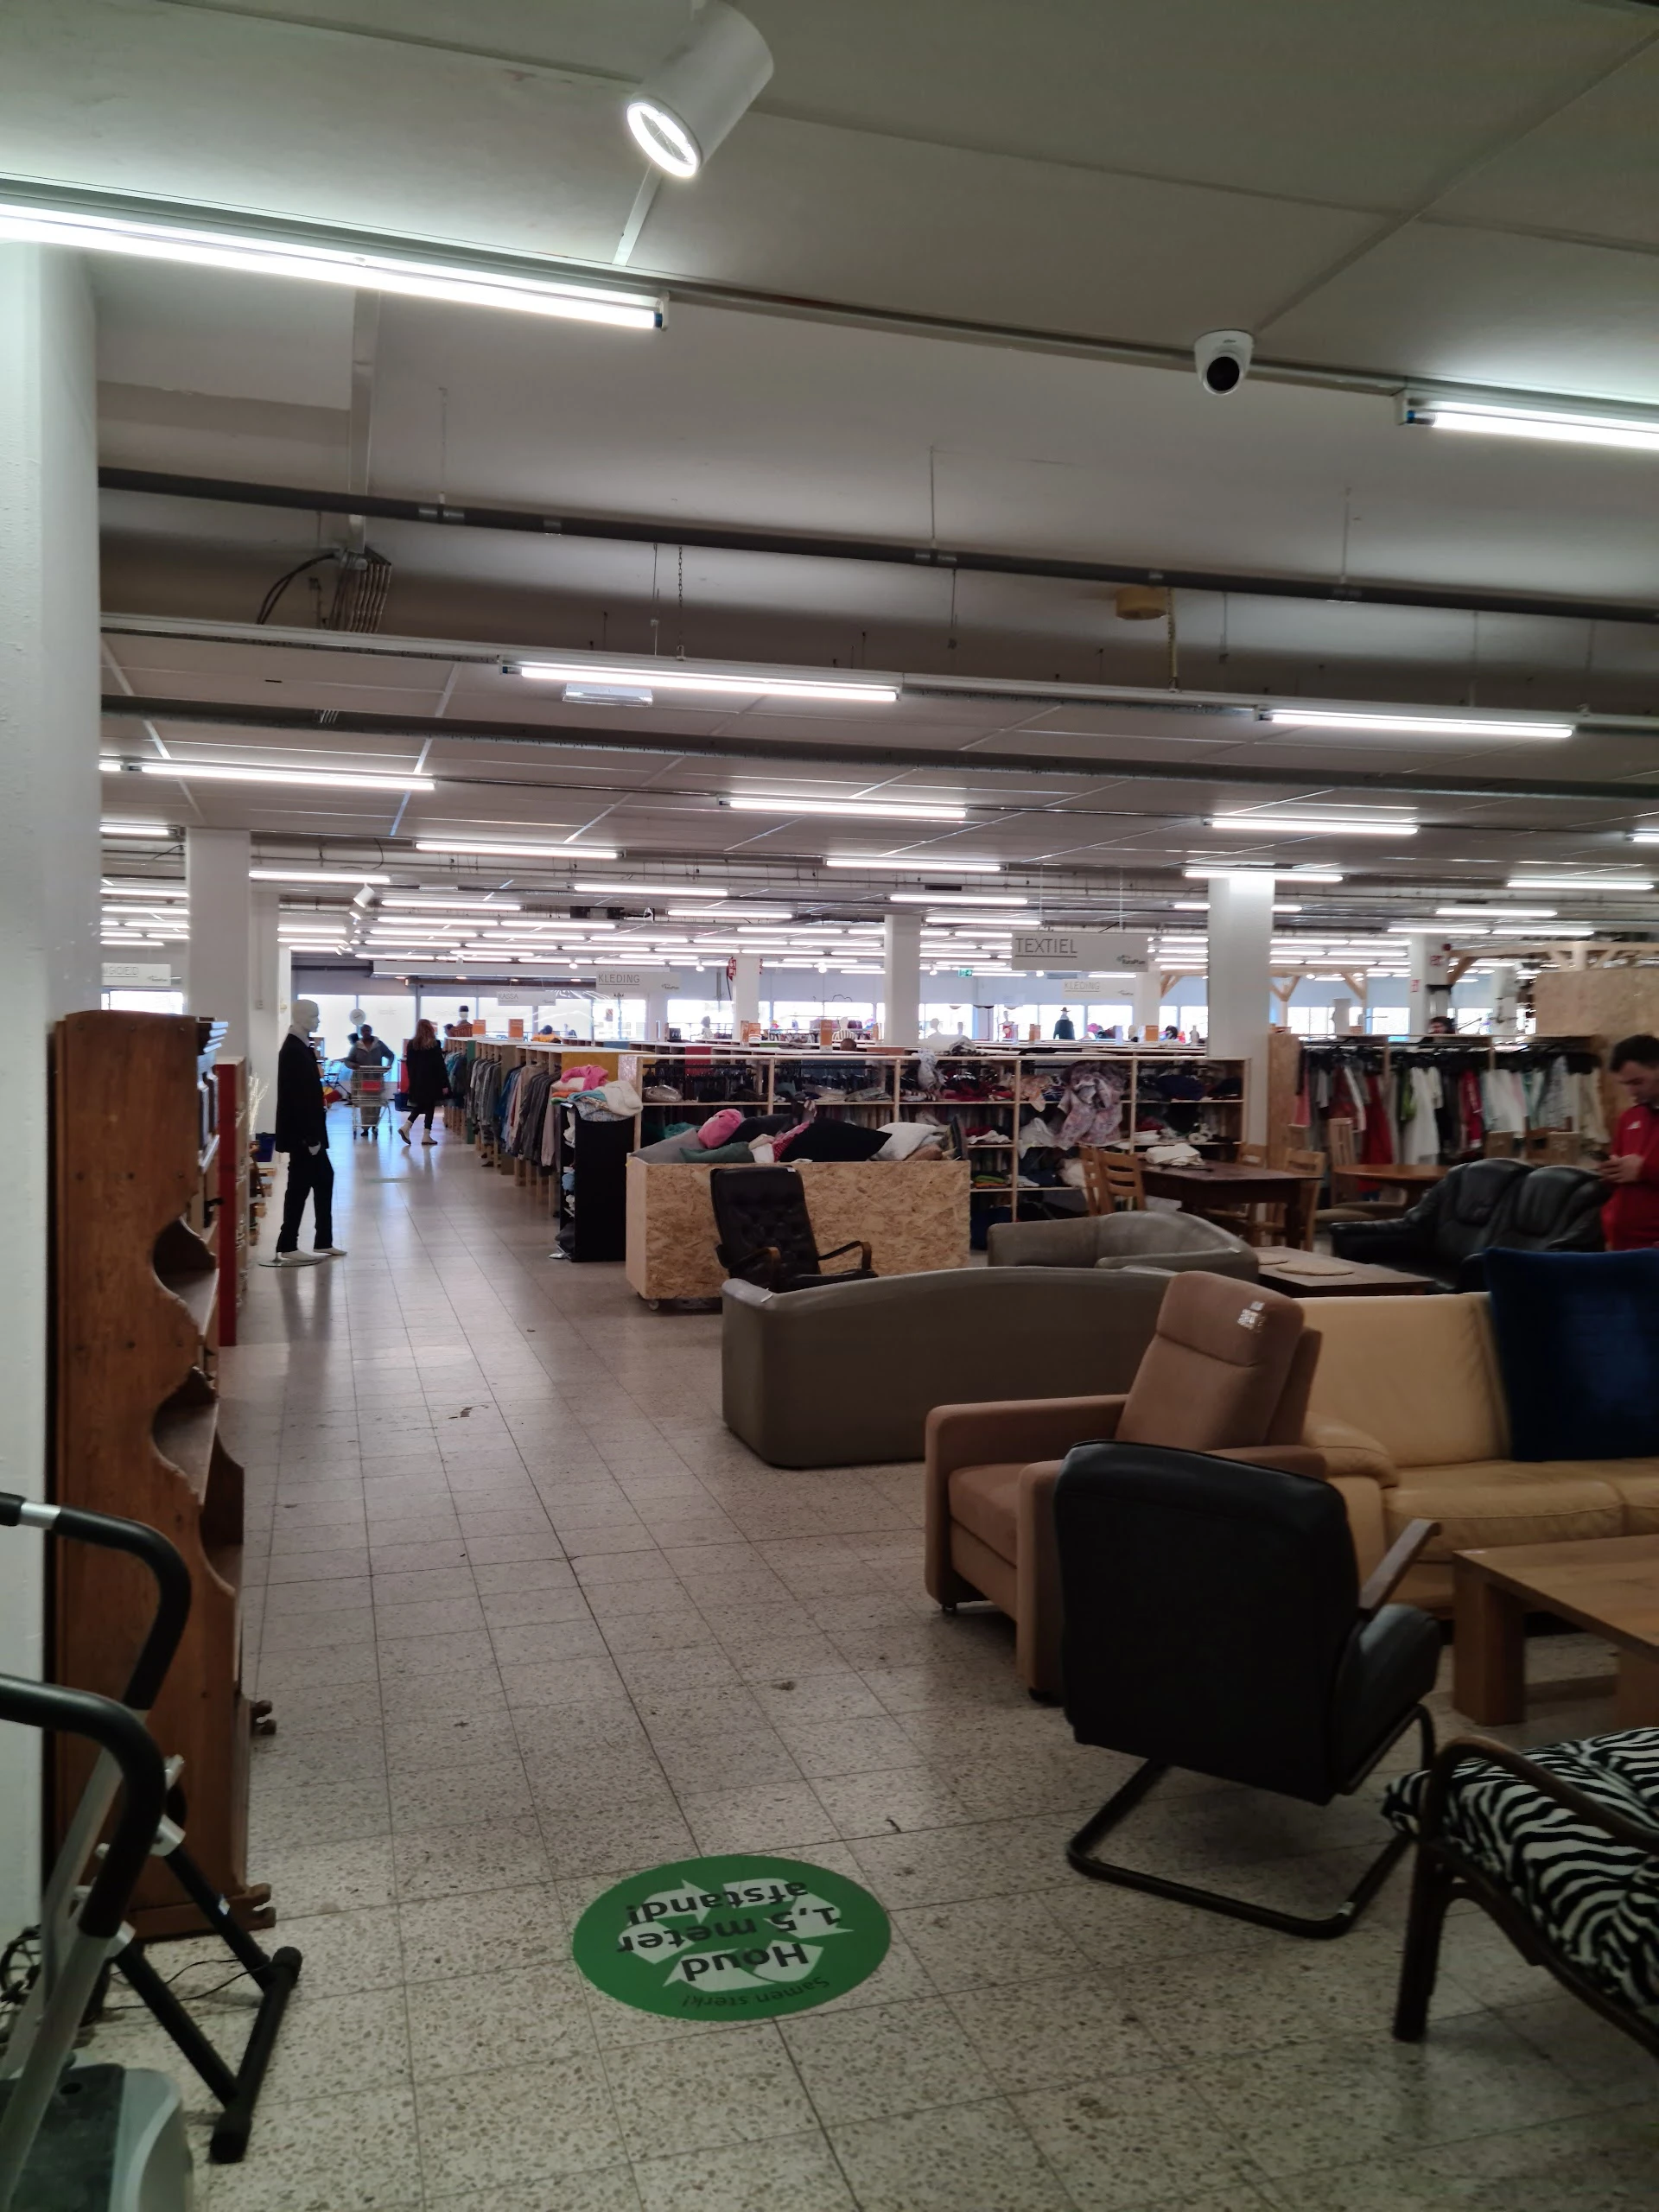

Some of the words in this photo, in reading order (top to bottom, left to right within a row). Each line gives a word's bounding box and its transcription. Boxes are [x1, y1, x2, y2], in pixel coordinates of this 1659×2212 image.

[1015, 938, 1078, 954] TEXTIEL
[598, 974, 640, 983] KLEDING
[1065, 981, 1100, 990] KLEDING
[626, 1881, 810, 1926] afstand!
[771, 1906, 842, 1933] 1,5
[616, 1917, 758, 1953] meter
[680, 1942, 810, 1982] Houd
[681, 1993, 749, 2009] sterk!
[747, 1976, 830, 2006] Samen
